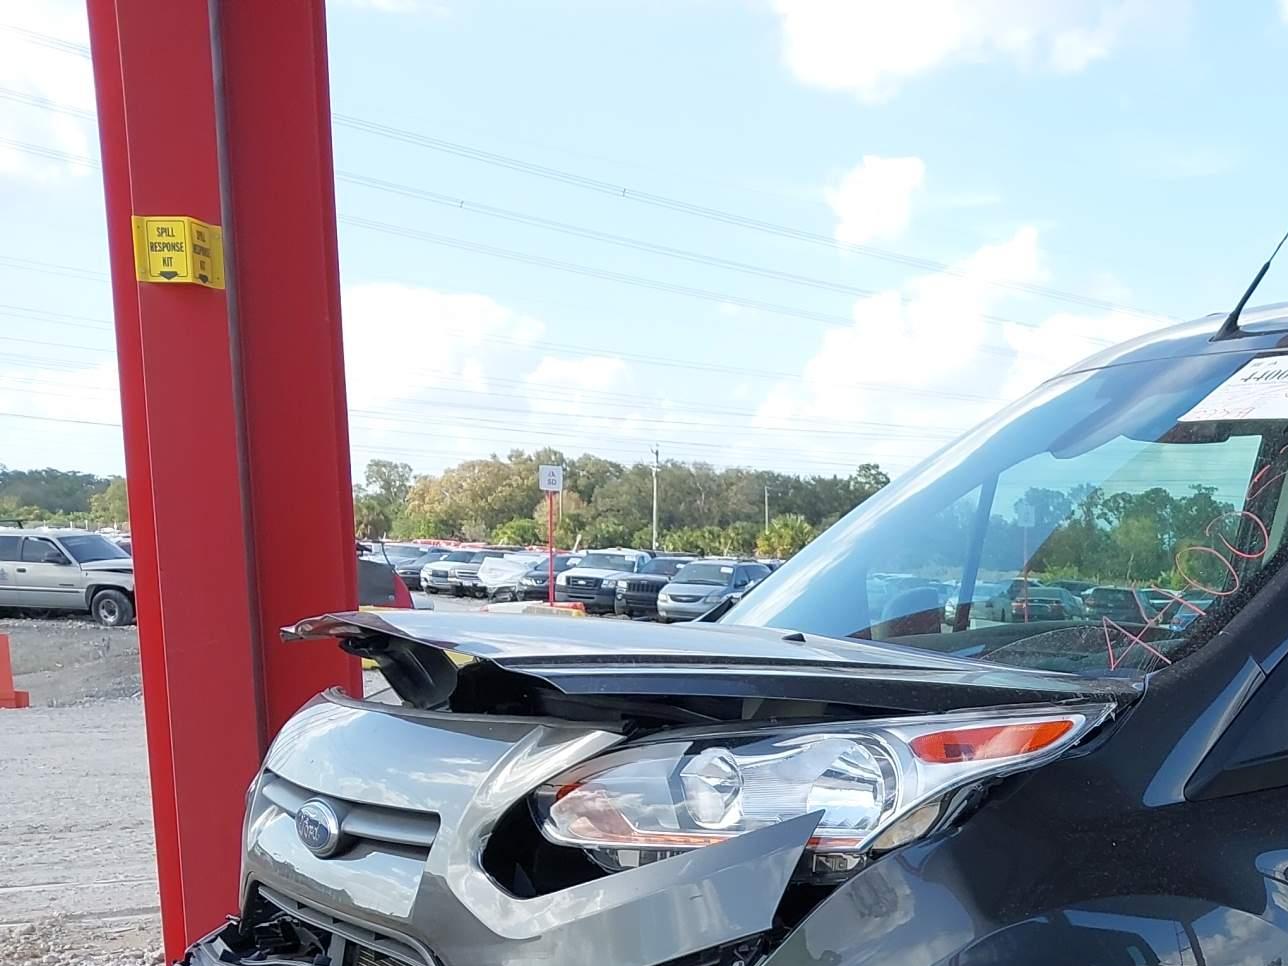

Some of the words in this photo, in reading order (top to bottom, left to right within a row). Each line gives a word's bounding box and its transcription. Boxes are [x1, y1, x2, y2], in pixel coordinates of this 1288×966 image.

[156, 227, 175, 237] SPILL
[150, 242, 184, 253] RESPONSE
[162, 257, 173, 267] KIT
